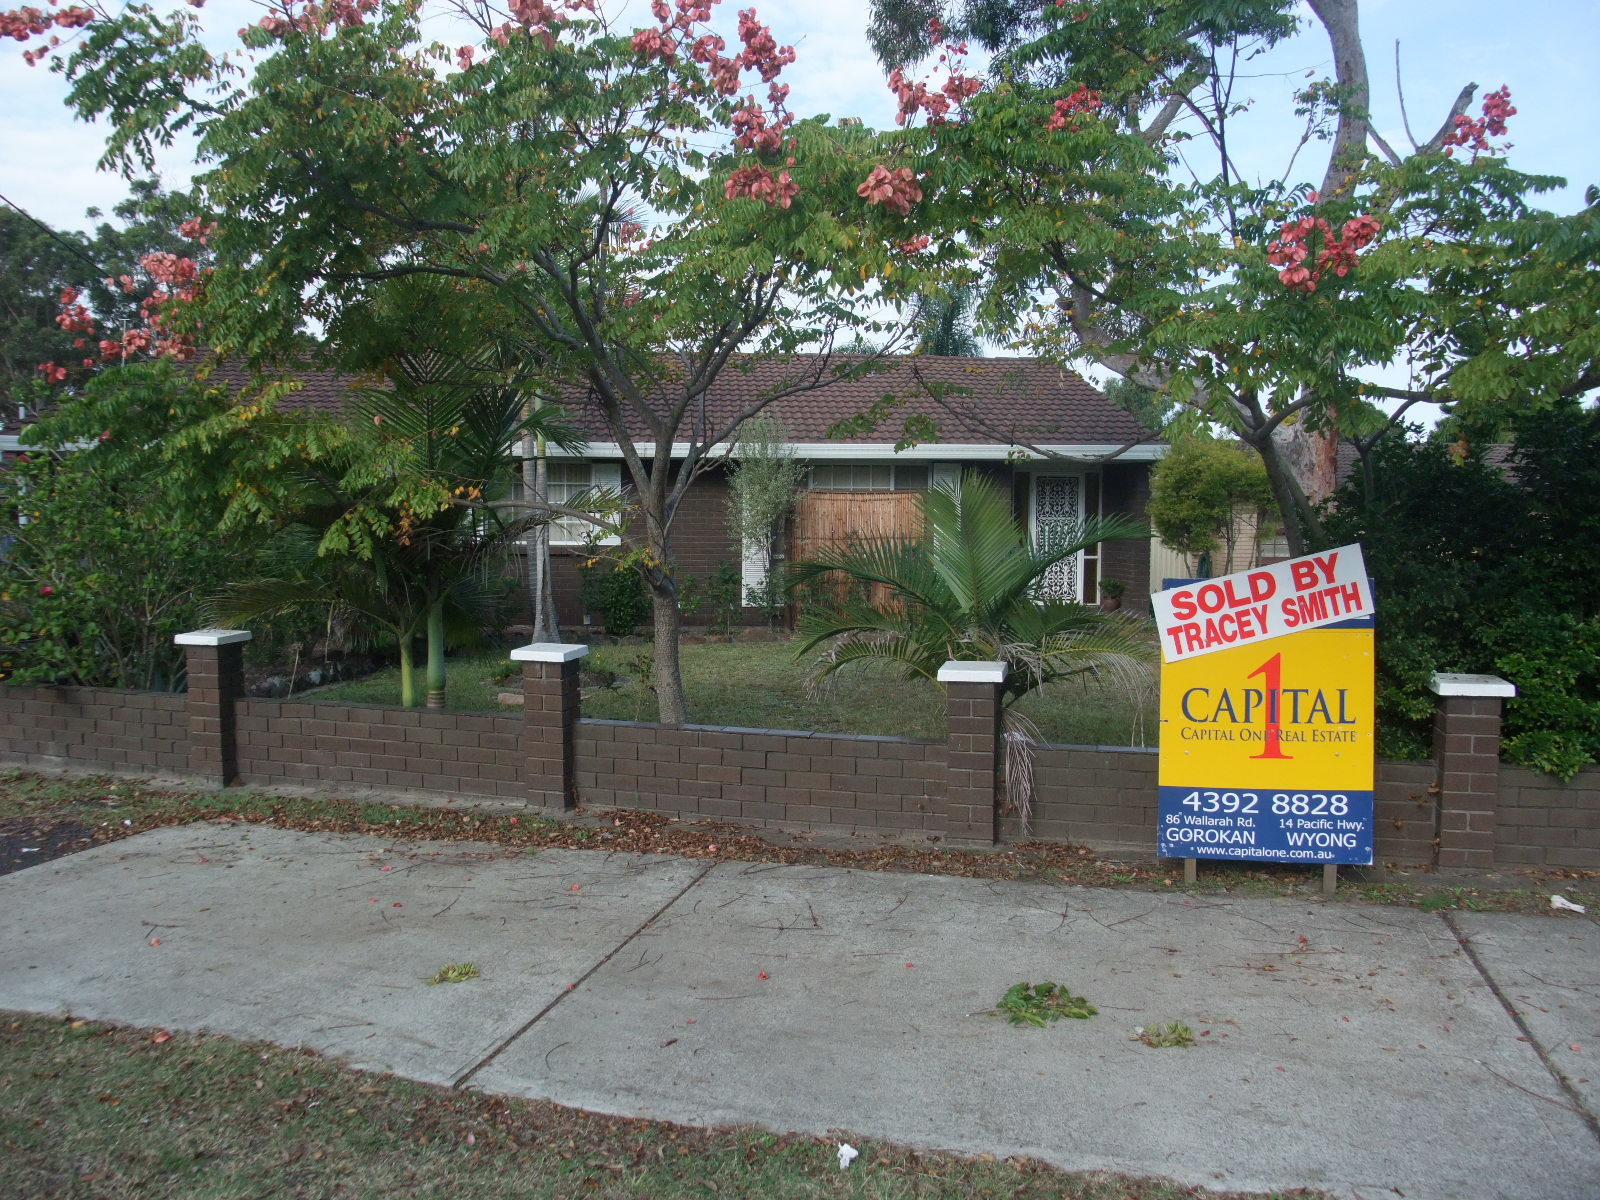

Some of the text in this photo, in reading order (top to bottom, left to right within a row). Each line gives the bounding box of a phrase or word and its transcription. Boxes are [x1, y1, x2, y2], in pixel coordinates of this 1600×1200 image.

[1171, 552, 1338, 620] SOLD BY
[1167, 582, 1362, 654] TRACEY SMITH
[1181, 688, 1356, 724] CAPITAL
[1247, 653, 1293, 759] 1
[1183, 792, 1348, 815] 4392 8828
[1166, 815, 1255, 827] 86 Wallarah Rd.
[1280, 819, 1364, 831] 14 Pacific Hwy.
[1166, 828, 1255, 844] GOROKAN
[1287, 832, 1356, 847] WYONG
[1197, 846, 1331, 859] www.capitalone.com.au
